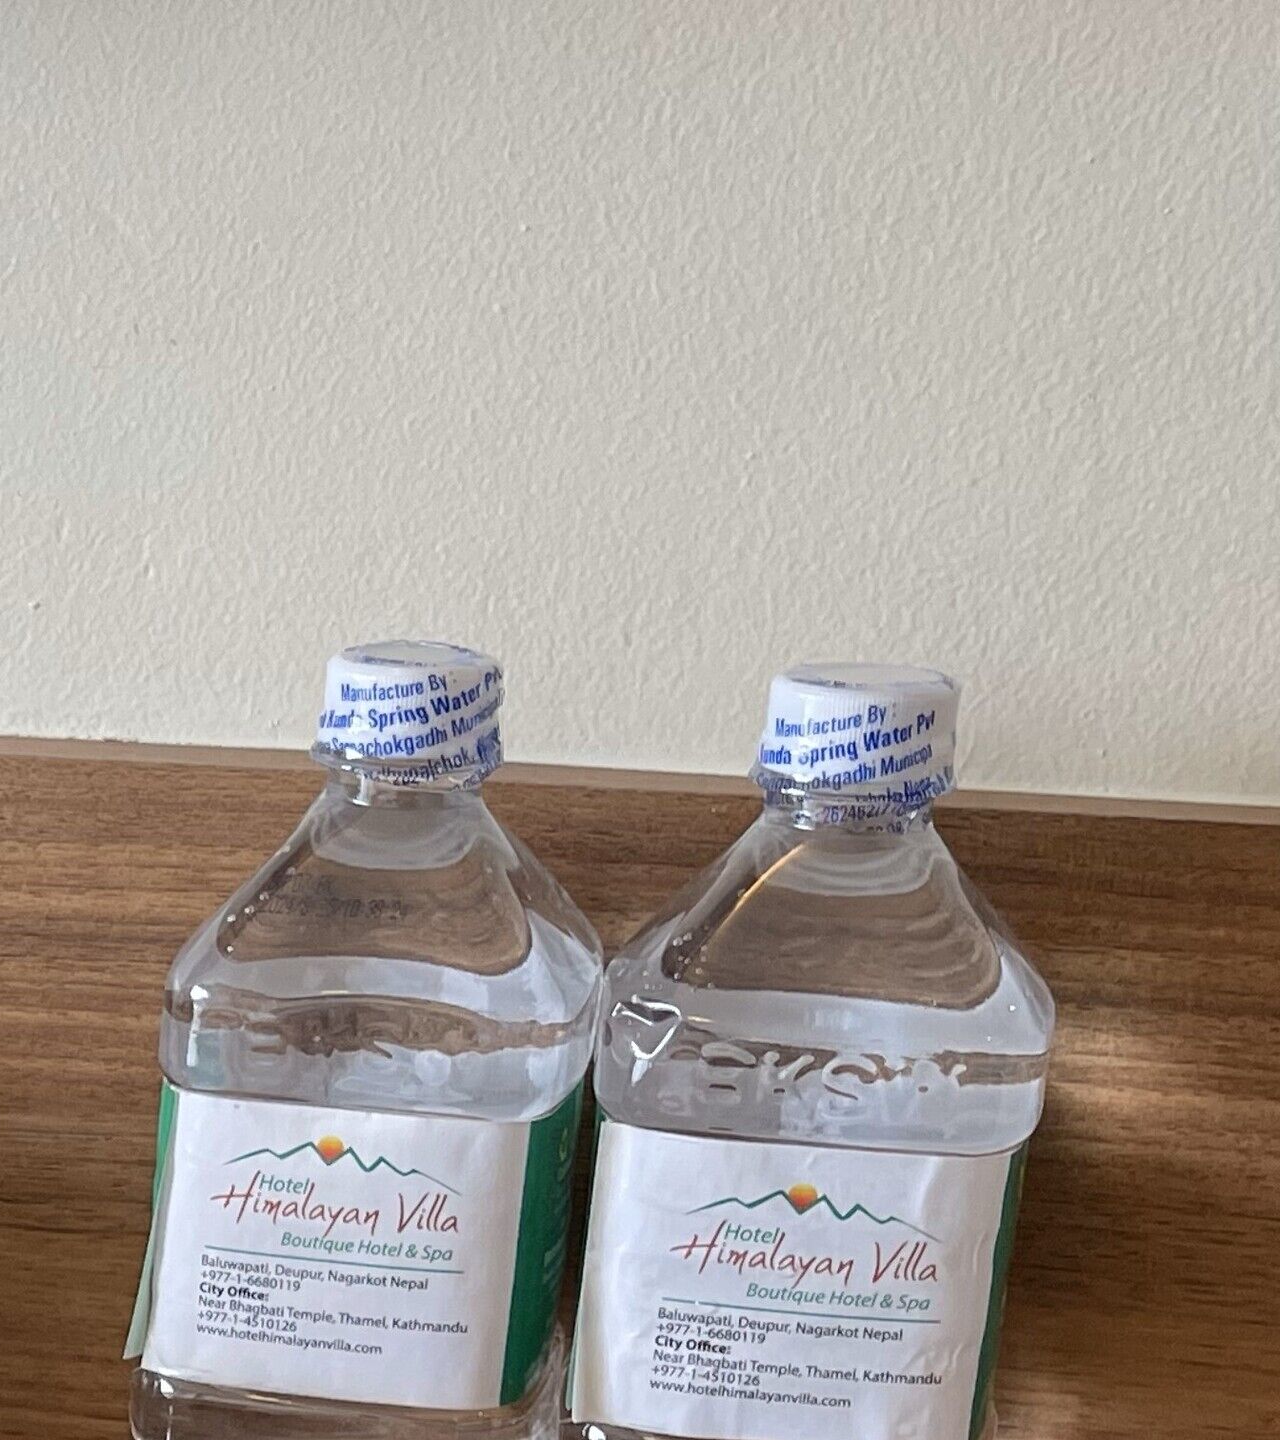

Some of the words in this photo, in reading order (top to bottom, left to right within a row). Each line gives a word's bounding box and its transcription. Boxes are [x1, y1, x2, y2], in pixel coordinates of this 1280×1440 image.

[341, 681, 425, 702] Manufacture
[428, 673, 448, 693] By
[368, 704, 430, 732] Spring
[430, 682, 482, 716] Water
[775, 713, 862, 739] Manufacture
[868, 705, 887, 726] By
[863, 723, 913, 753] Water
[259, 1175, 310, 1195] Hotel
[210, 1169, 380, 1238] Himalayan
[397, 1191, 459, 1234] Villa
[281, 1232, 355, 1255] Boutique
[357, 1239, 403, 1258] Hotel
[405, 1243, 418, 1259] &
[421, 1245, 454, 1264] Spa
[724, 1223, 781, 1244] Hotel
[669, 1219, 854, 1289] Himalayan
[872, 1240, 938, 1283] Villa
[200, 1269, 301, 1292] +977-1-6680119
[201, 1254, 272, 1276] Baluwapati,
[275, 1264, 325, 1282] Deupur,
[328, 1270, 387, 1286] Nagarkot
[390, 1275, 429, 1291] Nepal
[199, 1282, 225, 1298] City
[227, 1286, 269, 1302] Office:
[746, 1282, 825, 1306] Boutique
[828, 1290, 879, 1308] Hotel
[880, 1295, 893, 1309] &
[896, 1294, 931, 1313] Spa
[198, 1295, 226, 1310] Near
[229, 1299, 285, 1318] Bhagbati
[287, 1306, 336, 1324] Temple,
[339, 1312, 389, 1330] Thamel,
[392, 1317, 469, 1334] Kathmandu
[198, 1310, 298, 1333] +977-1-4510126
[657, 1307, 734, 1328] Baluwapati,
[738, 1316, 793, 1334] Deupur,
[796, 1322, 859, 1339] Nagarkot
[863, 1327, 904, 1343] Nepal
[197, 1323, 383, 1355] www.hotelhimalayanvilla.com
[654, 1335, 683, 1350] City
[686, 1339, 732, 1355] Office:
[656, 1322, 766, 1344] +977-1-6680119
[652, 1365, 761, 1387] +977-1-4510126
[653, 1349, 684, 1365] Near
[687, 1354, 747, 1374] Bhagbati
[750, 1361, 803, 1378] Temple,
[806, 1366, 859, 1383] Thamel,
[863, 1370, 942, 1385] Kathmandu
[649, 1379, 852, 1408] www.hotelhimalayanvilla.com
